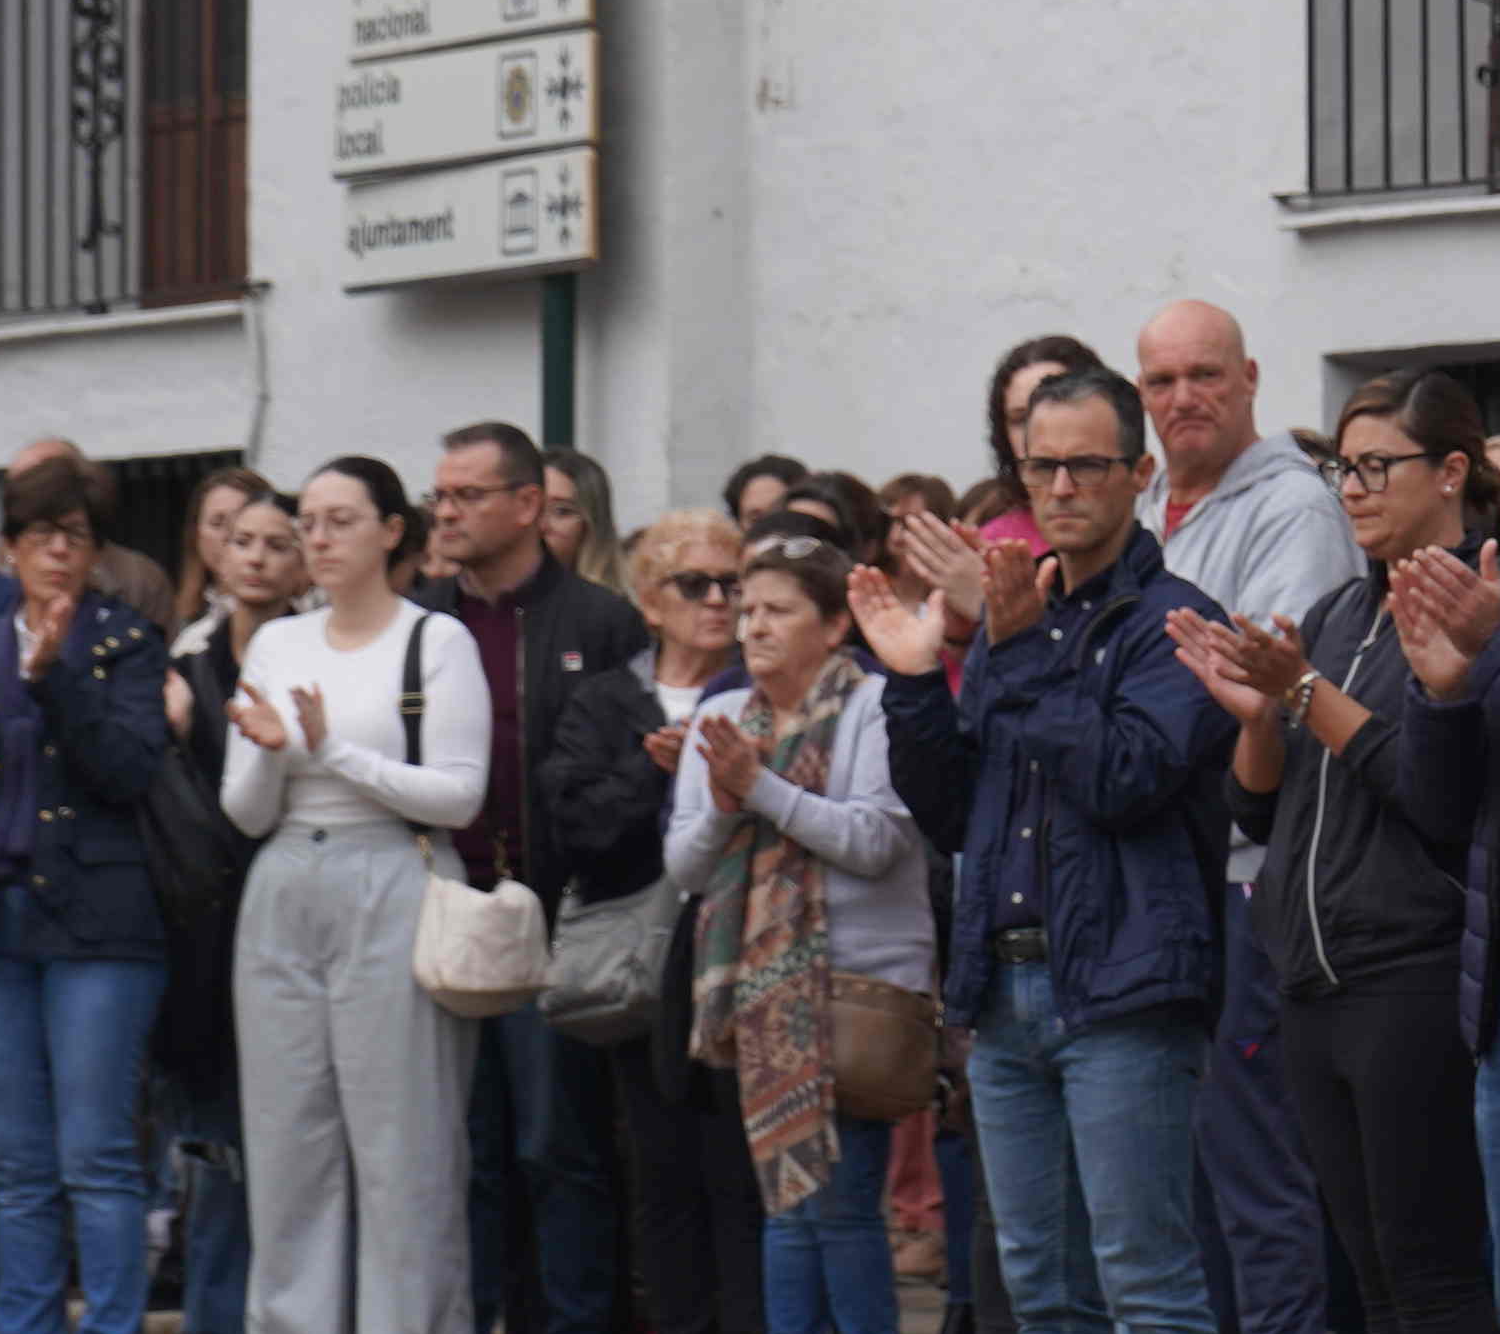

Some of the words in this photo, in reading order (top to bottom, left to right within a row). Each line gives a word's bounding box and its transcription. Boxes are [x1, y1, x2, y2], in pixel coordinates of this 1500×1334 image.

[354, 4, 430, 44] nacional
[335, 119, 386, 160] local
[346, 207, 455, 259] ajuntament
